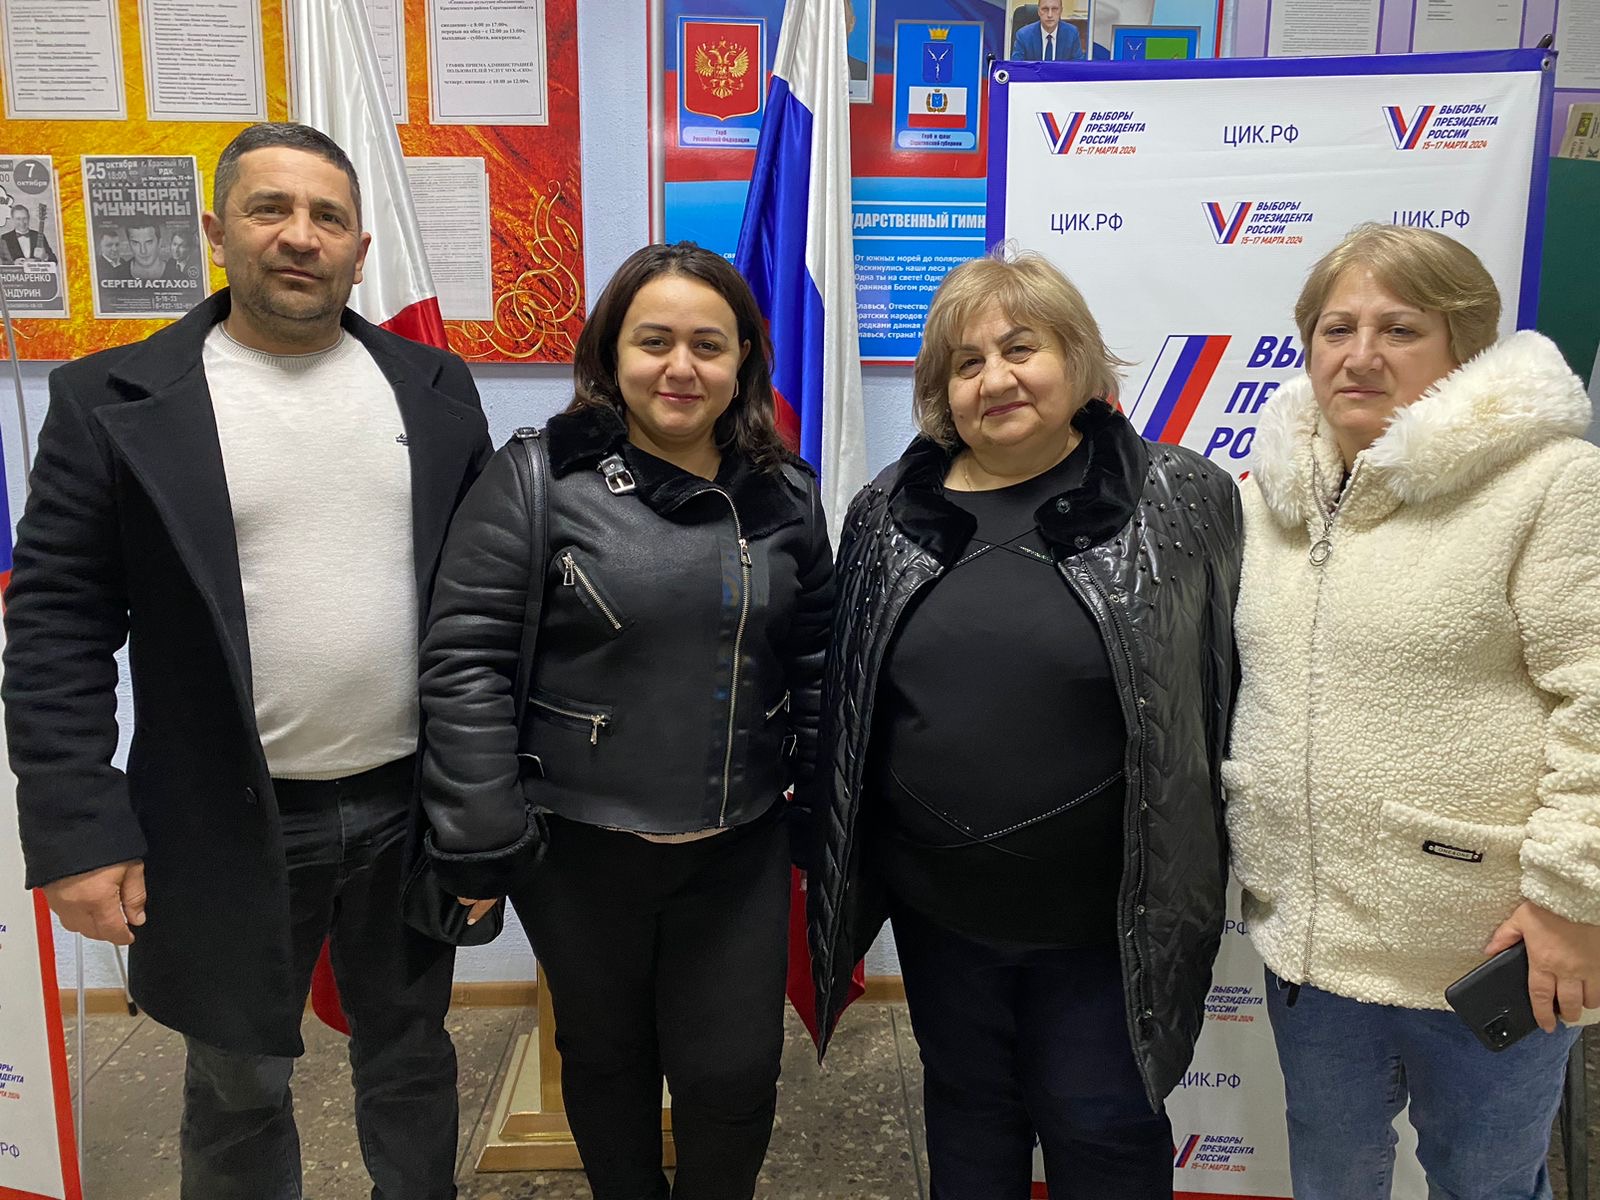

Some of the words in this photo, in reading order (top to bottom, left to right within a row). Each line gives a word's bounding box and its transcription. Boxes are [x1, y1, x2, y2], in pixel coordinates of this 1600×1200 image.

[1439, 104, 1486, 115] ВЫБОРЫ
[1090, 111, 1134, 121] ВЫБОРЫ
[1433, 116, 1499, 127] ПРЕЗИДЕНТА
[1085, 123, 1146, 133] ПРЕЗИДЕНТА
[1224, 124, 1299, 147] ЦИК.РФ
[1427, 129, 1470, 139] РОССИИ
[1079, 135, 1119, 144] РОССИИ
[1444, 140, 1468, 149] МАРТА
[1469, 140, 1488, 149] 2024
[1096, 146, 1118, 155] МАРТА
[1119, 146, 1137, 155] 2024
[106, 160, 138, 170] октября
[148, 159, 177, 168] Красный
[178, 159, 190, 168] Кут
[26, 163, 35, 178] 7
[86, 162, 106, 180] 25
[158, 168, 174, 176] РДК
[92, 189, 123, 202] ЧТО
[128, 188, 190, 201] ТВОРЯТ
[92, 201, 191, 216] МУЖЧИНЫ
[1256, 201, 1301, 211] ВЫБОРЫ
[951, 214, 986, 228] ГИМН
[1250, 213, 1314, 223] ПРЕЗИДЕНТА
[1051, 213, 1123, 234] ЦИК.РФ
[1245, 225, 1286, 234] РОССИИ
[1261, 236, 1285, 245] МАРТА
[1286, 236, 1303, 245] 2024
[897, 254, 921, 263] морей
[854, 265, 904, 273] Раскинулись
[100, 278, 142, 288] СЕРГЕЙ
[144, 280, 198, 288] АСТАХОВ
[855, 274, 874, 282] Одна
[888, 302, 928, 310] Отечество
[1212, 986, 1253, 994] ВЫБОРЫ
[1208, 996, 1264, 1005] ПРЕЗИДЕНТА
[1204, 1135, 1244, 1144] ВЫБОРЫ
[1199, 1144, 1255, 1154] ПРЕЗИДЕНТА
[1194, 1154, 1230, 1162] РОССИИ
